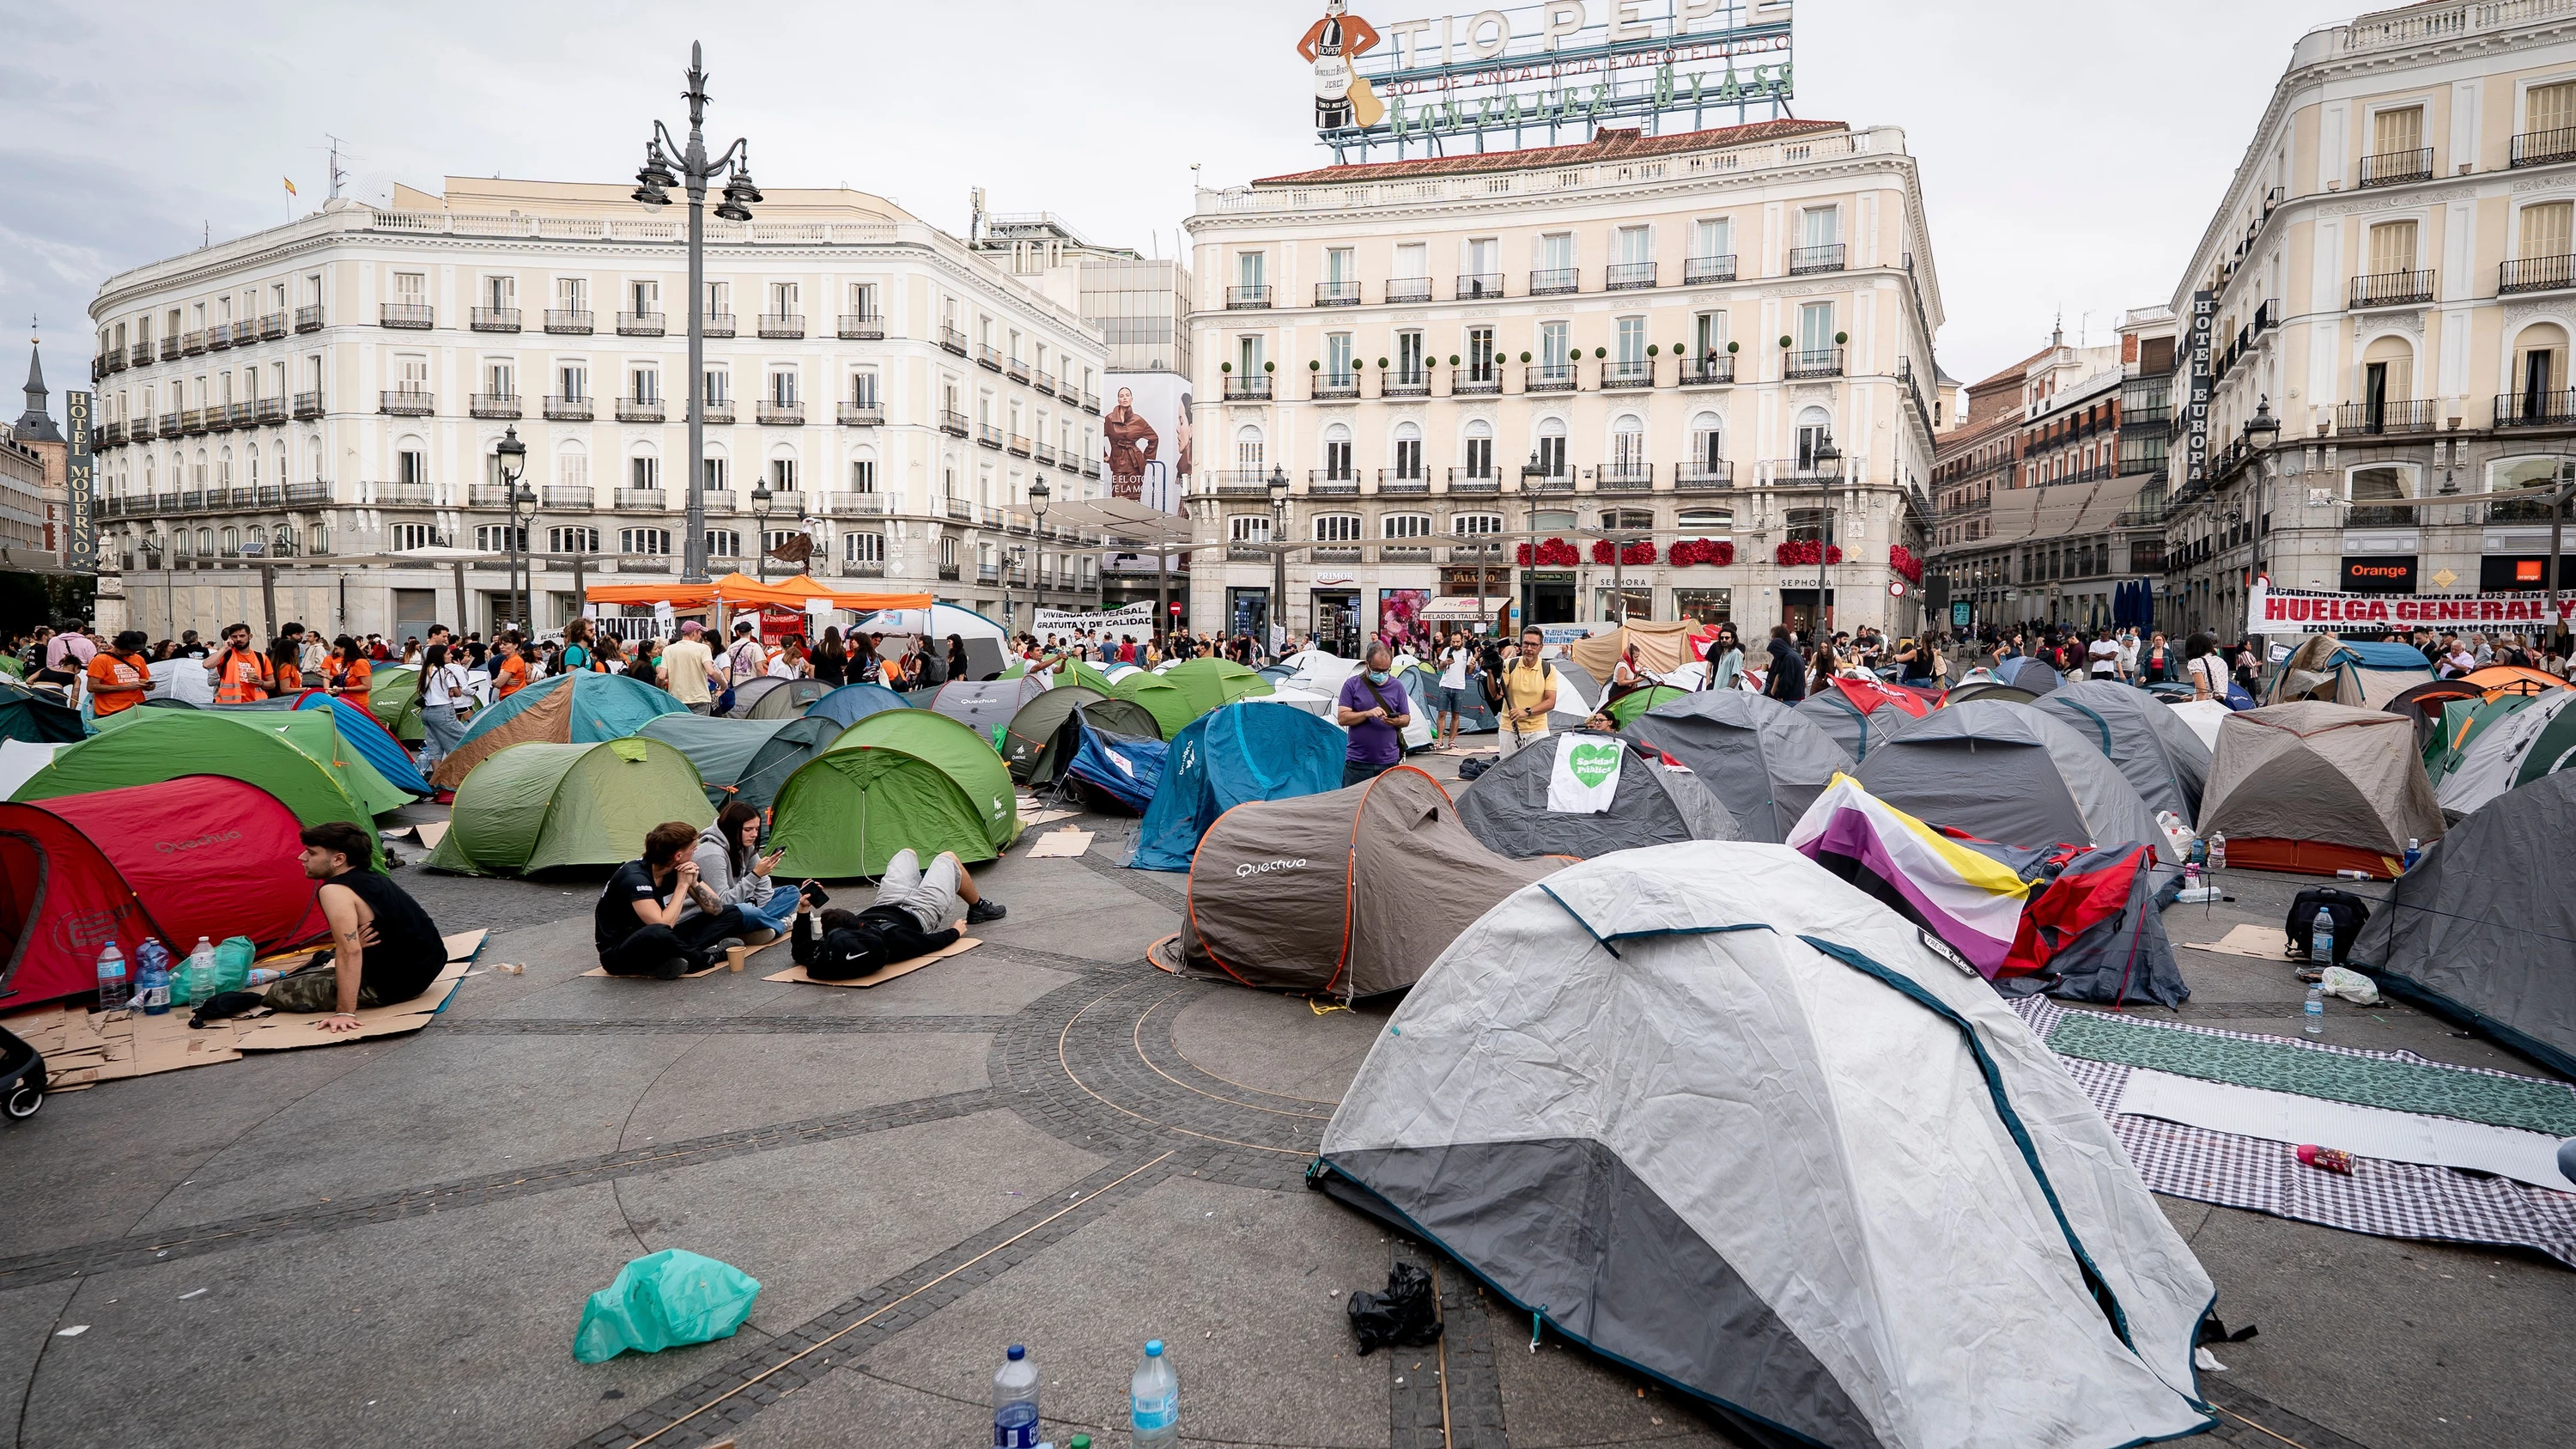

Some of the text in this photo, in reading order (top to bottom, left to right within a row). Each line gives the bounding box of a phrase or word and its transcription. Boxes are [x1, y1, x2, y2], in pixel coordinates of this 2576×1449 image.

[1391, 10, 1510, 69] TIO
[1386, 34, 1789, 96] SOL DE ANDALUCIA EMBOTELLADO
[1325, 78, 1344, 89] JEREZ
[1390, 61, 1794, 136] GONZALEZ BYASS
[2189, 300, 2212, 480] HOTEL EUROPA
[70, 392, 91, 554] HOTEL MODERNO
[1118, 475, 1128, 484] EL
[1121, 484, 1132, 493] LA
[1316, 572, 1354, 581] PRIMOR
[1454, 574, 1495, 583] PALAZO
[2351, 564, 2407, 578] Orange
[2264, 598, 2389, 621] HUELGA
[2396, 600, 2546, 620] GENERAL
[595, 618, 660, 640] CONTRA
[1037, 620, 1077, 629] GRATUITA
[1577, 757, 1615, 766] Sanidad
[155, 830, 242, 855] Quechua
[1236, 859, 1306, 877] Quechua
[1926, 937, 1971, 973] FRESH BLACK
